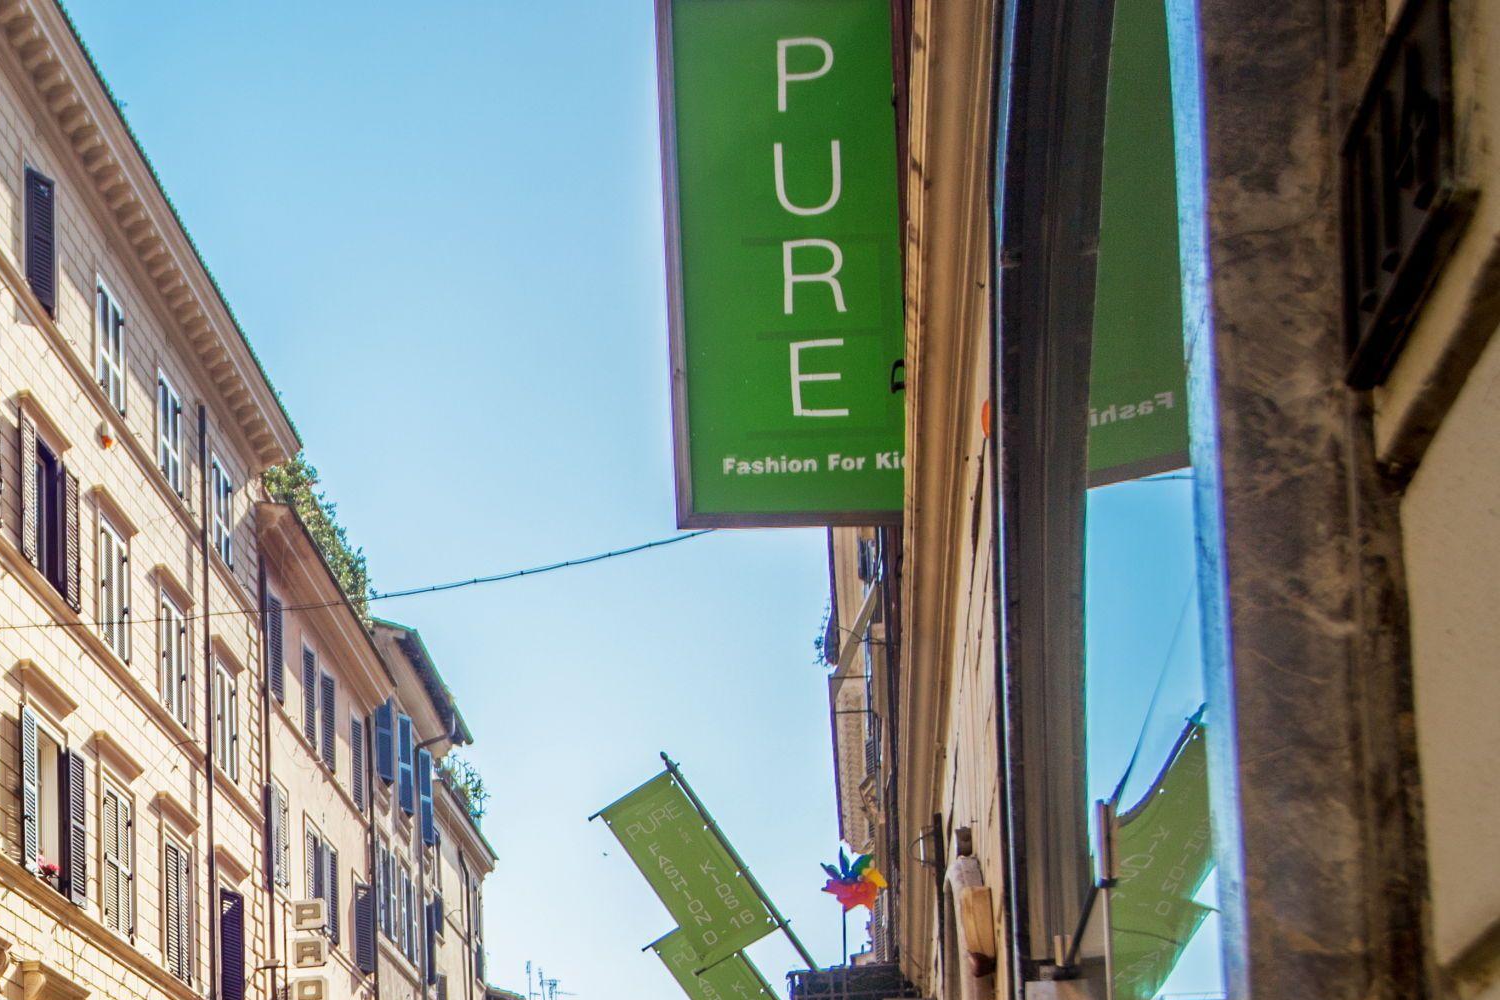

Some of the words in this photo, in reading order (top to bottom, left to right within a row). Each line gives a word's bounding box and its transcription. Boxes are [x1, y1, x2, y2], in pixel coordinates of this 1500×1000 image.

[773, 37, 850, 417] PURE
[722, 455, 818, 475] Fashion
[827, 453, 866, 472] For
[875, 451, 905, 470] Ki
[625, 800, 683, 842] PURE
